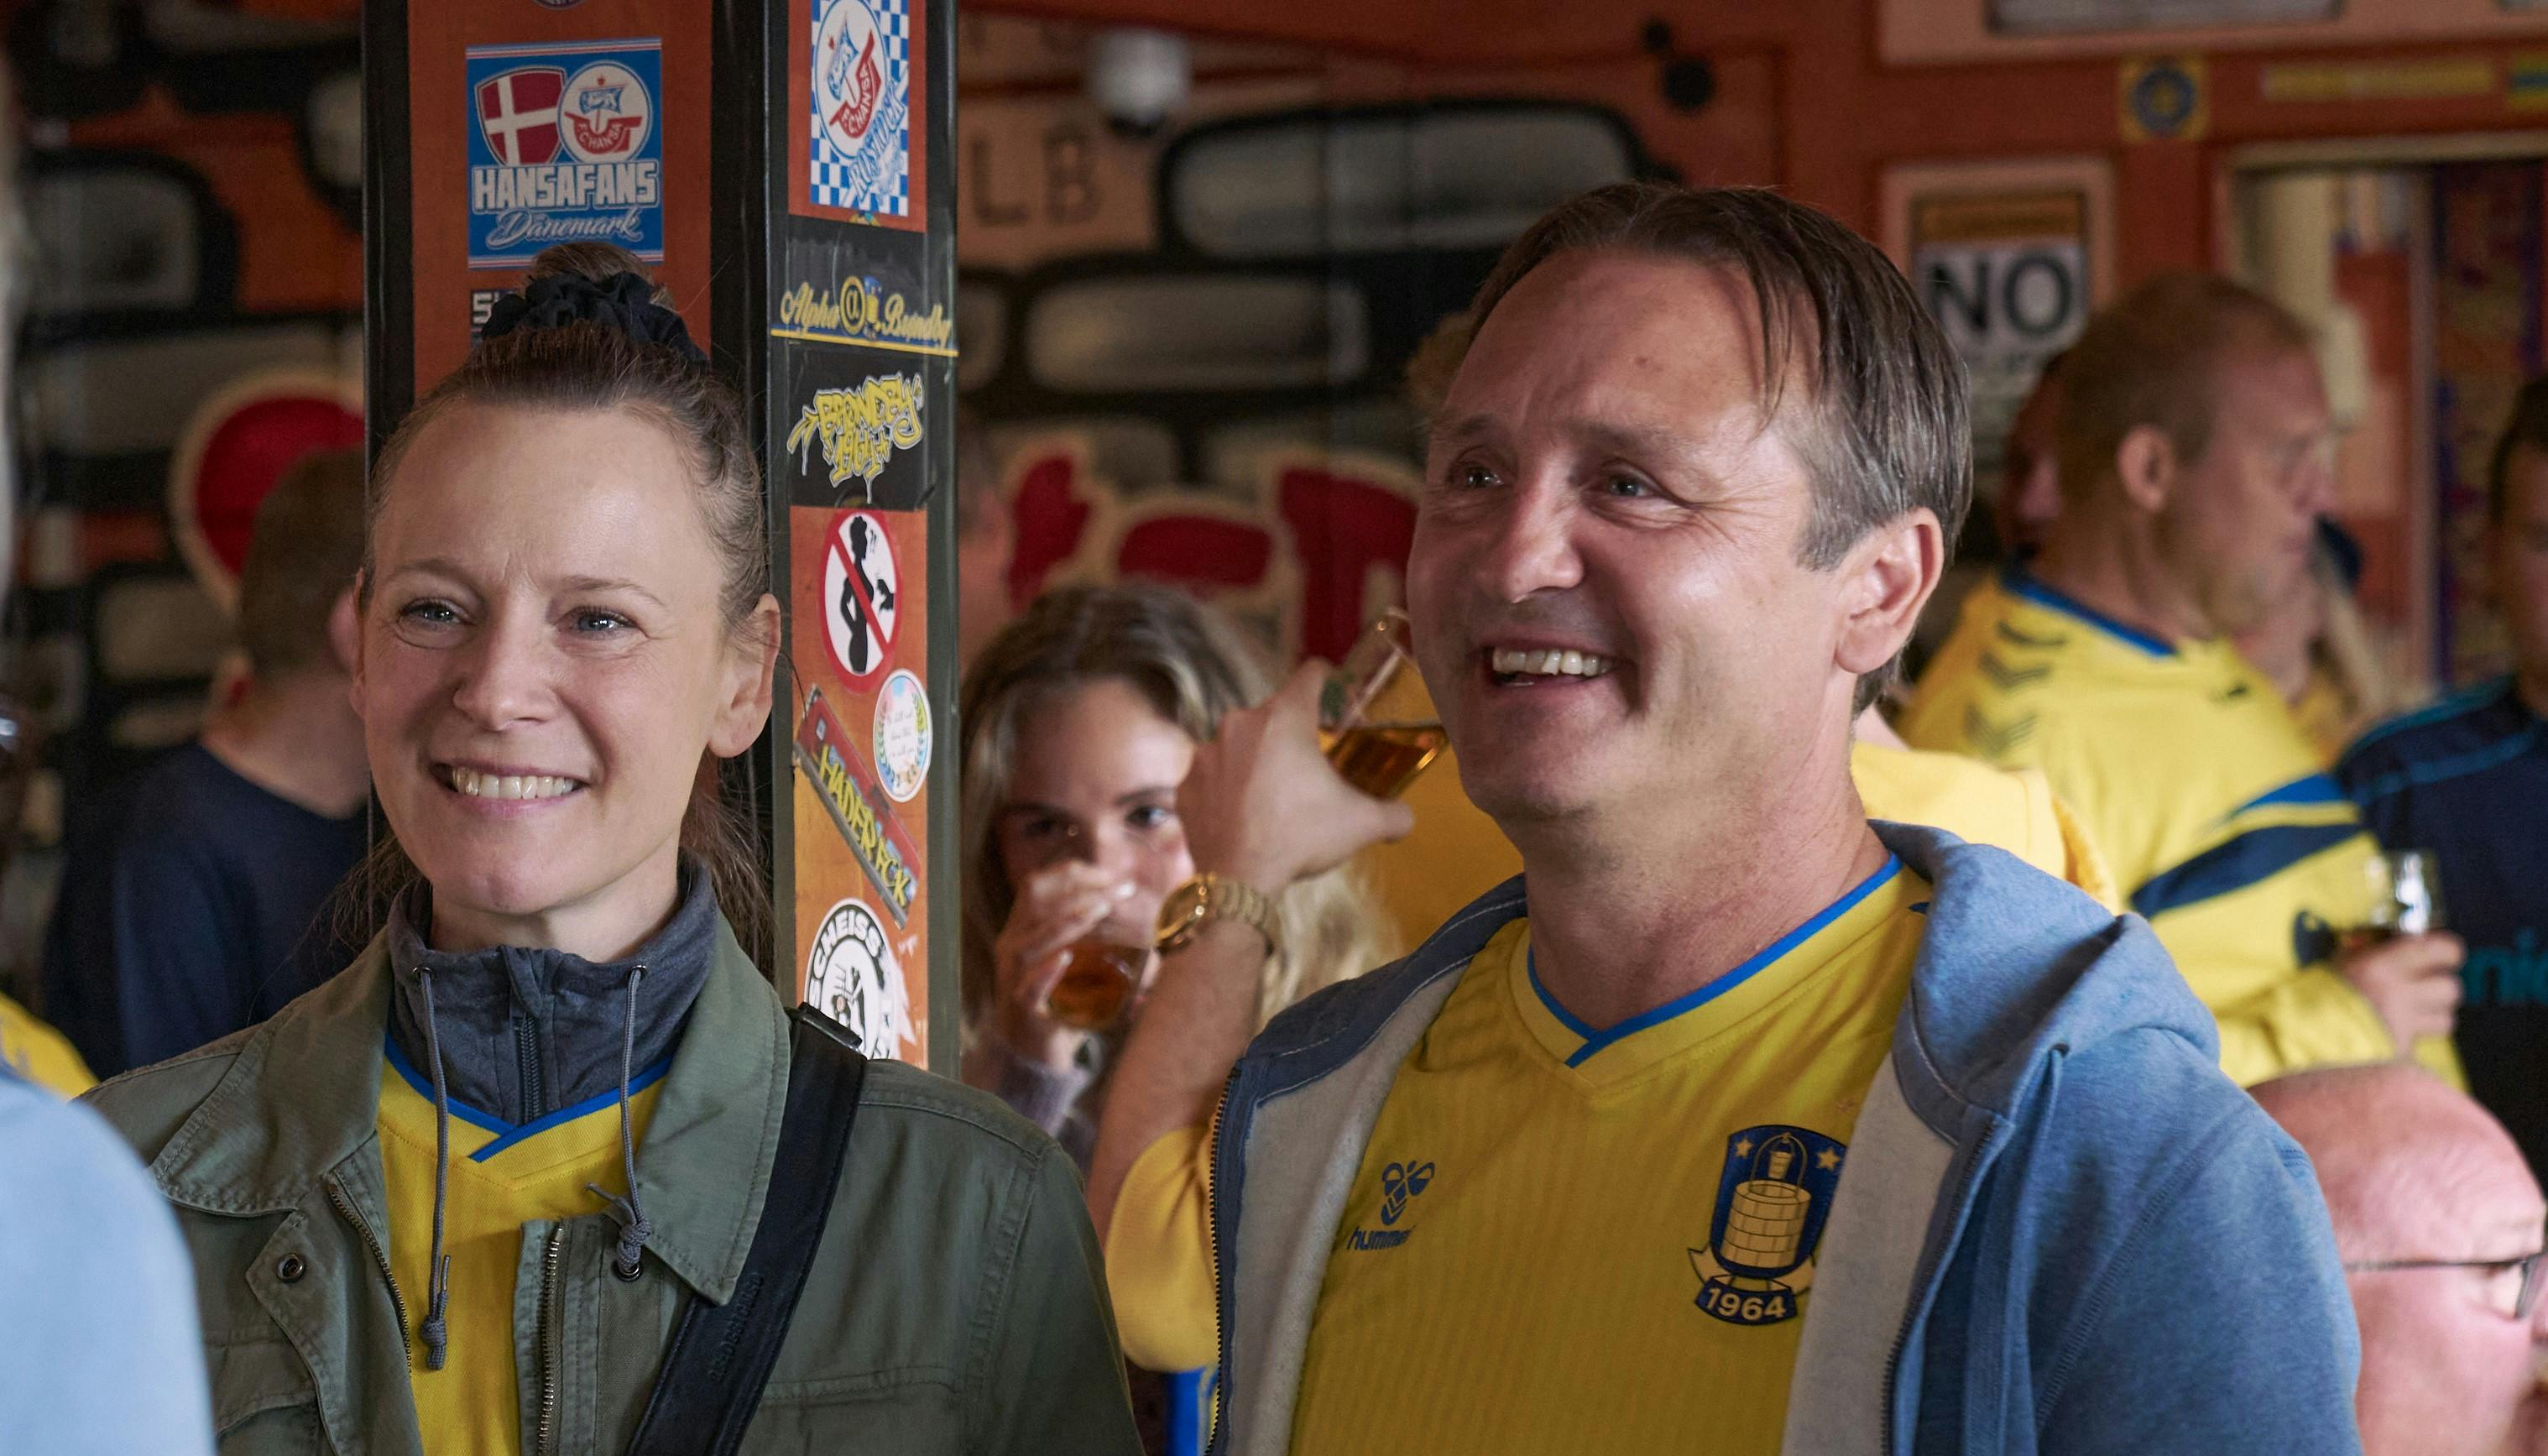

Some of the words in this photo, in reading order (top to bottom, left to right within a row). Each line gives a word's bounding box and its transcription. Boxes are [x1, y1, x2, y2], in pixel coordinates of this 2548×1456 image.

[473, 160, 658, 212] HANSAFANS
[1928, 253, 2073, 337] NO
[1705, 1286, 1786, 1321] 1964
